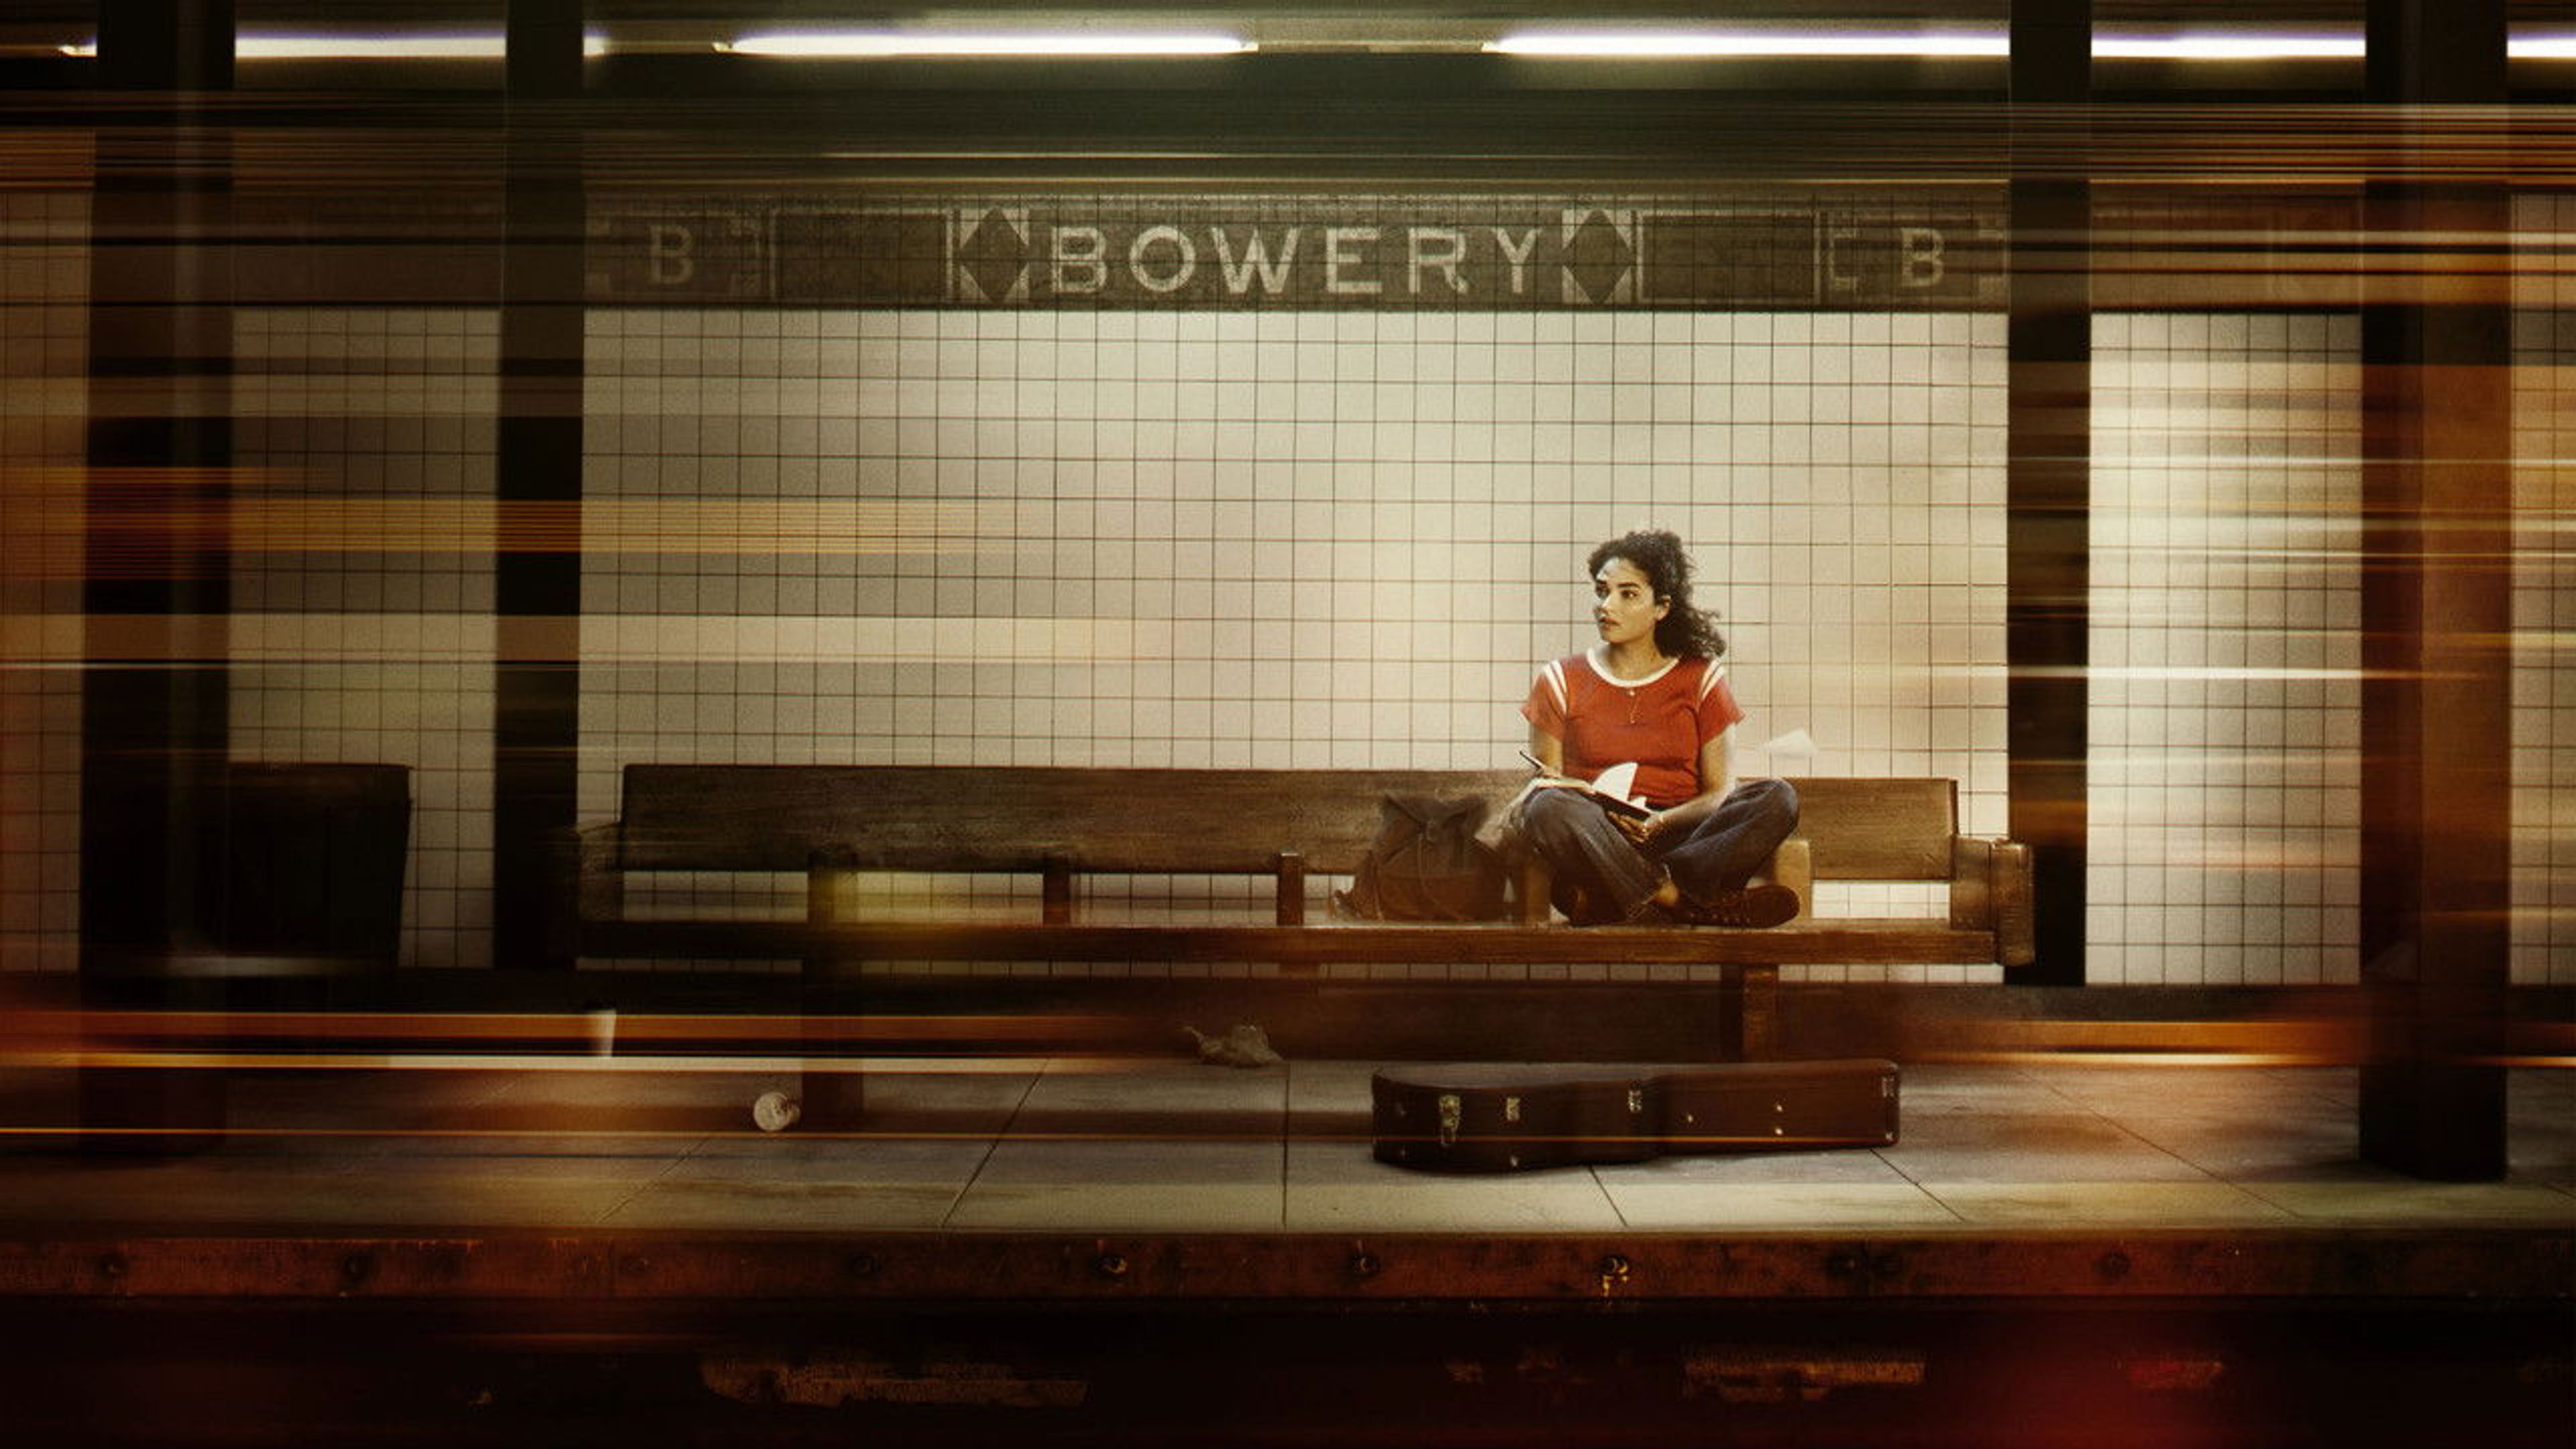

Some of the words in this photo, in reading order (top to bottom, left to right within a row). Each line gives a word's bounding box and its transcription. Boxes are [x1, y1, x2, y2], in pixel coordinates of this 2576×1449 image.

[649, 225, 693, 284] B
[1051, 225, 1542, 294] BOWERY
[1900, 227, 1945, 287] B
